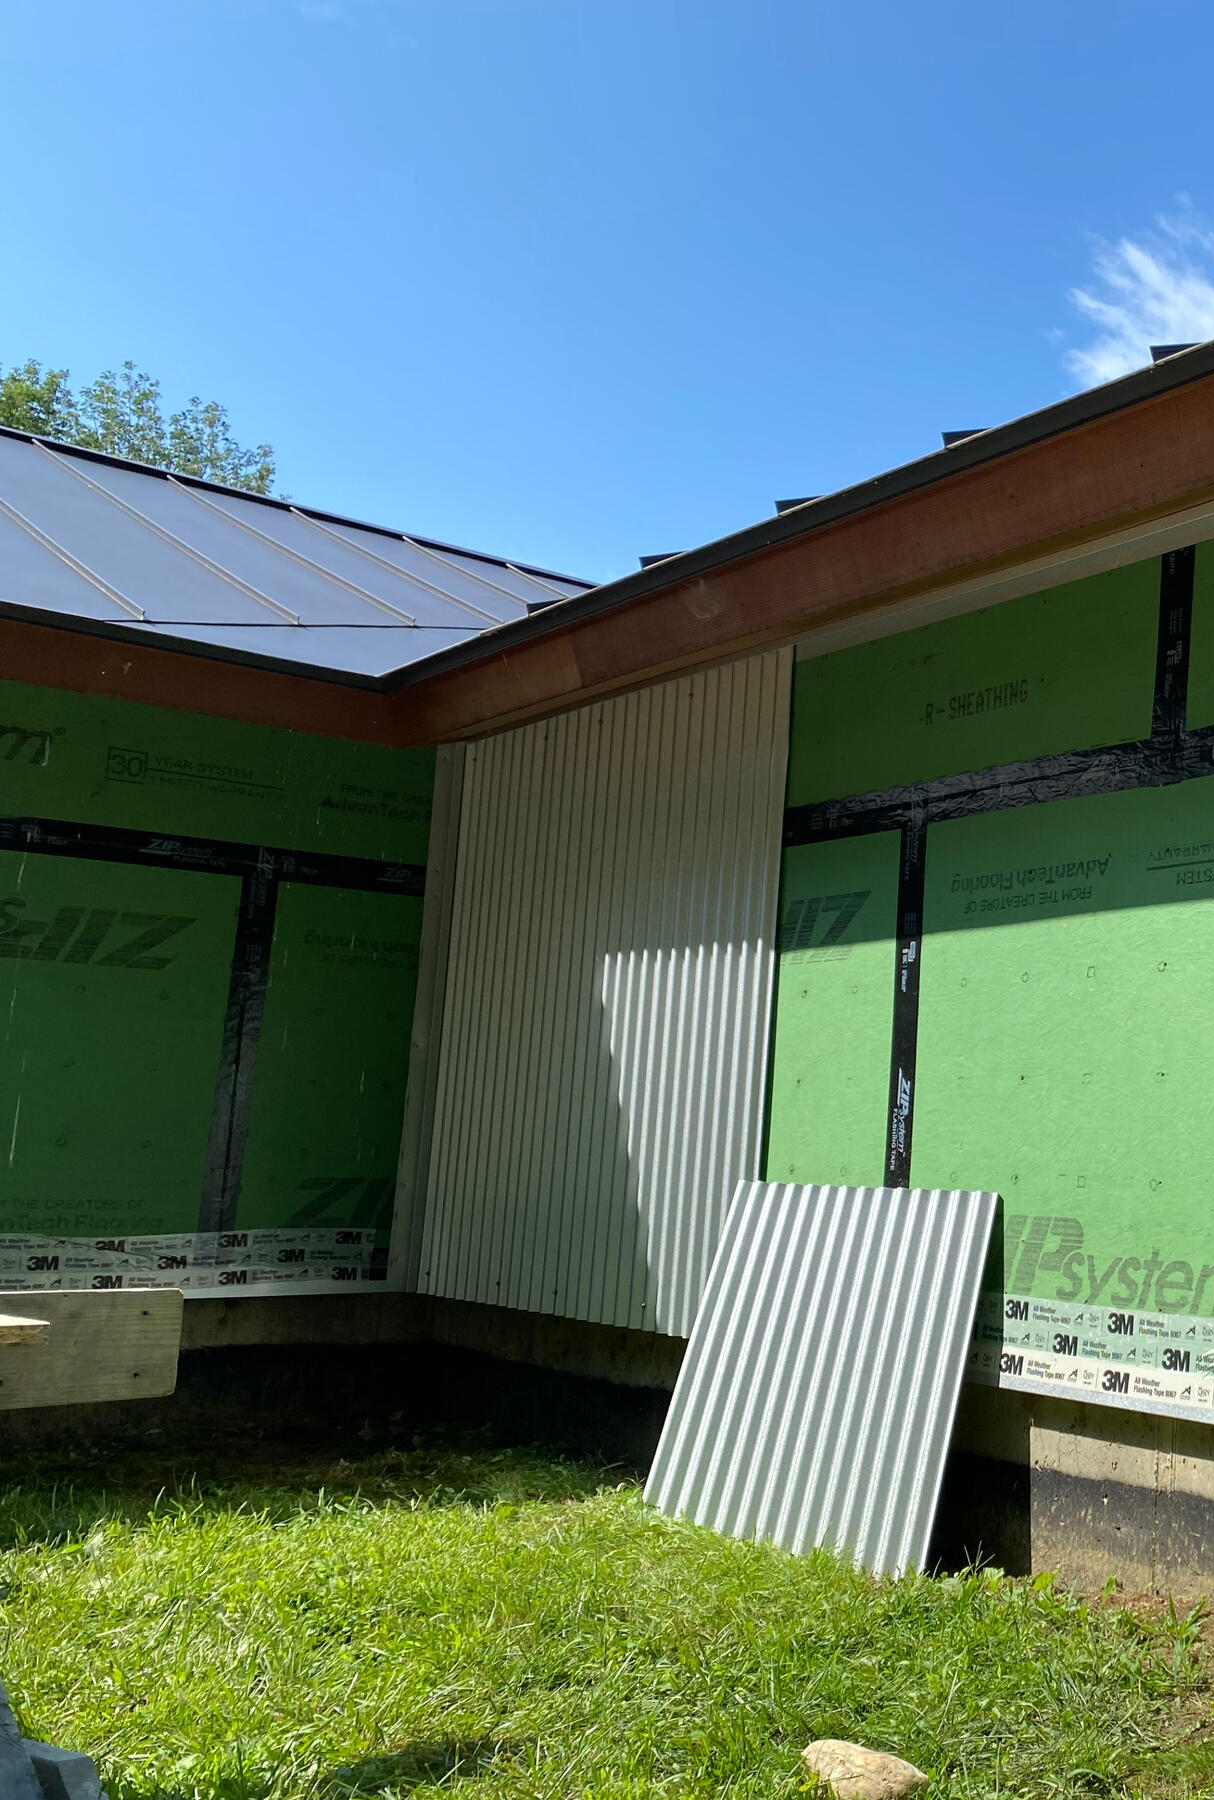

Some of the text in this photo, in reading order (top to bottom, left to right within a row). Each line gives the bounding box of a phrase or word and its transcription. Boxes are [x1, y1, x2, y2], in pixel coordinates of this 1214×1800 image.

[110, 754, 143, 778] 30
[951, 857, 1110, 894] AdvanTech Flooring
[1038, 888, 1060, 905] THE
[1061, 886, 1093, 901] FROM
[891, 1108, 899, 1149] FLASHING
[218, 1233, 248, 1248] 3M
[335, 1231, 362, 1245] 3M
[26, 1255, 59, 1271] 3M
[157, 1255, 188, 1270] 3M
[278, 1248, 306, 1263] 3M
[218, 1270, 247, 1286] 3M
[331, 1266, 358, 1280] 3M
[91, 1275, 123, 1289] 3M
[1005, 1299, 1029, 1321] 3M
[1107, 1312, 1134, 1336] 3M
[1053, 1333, 1078, 1356] 3M
[1000, 1353, 1024, 1376] 3M
[1162, 1348, 1191, 1373] 3M
[1102, 1370, 1130, 1394] 3M
